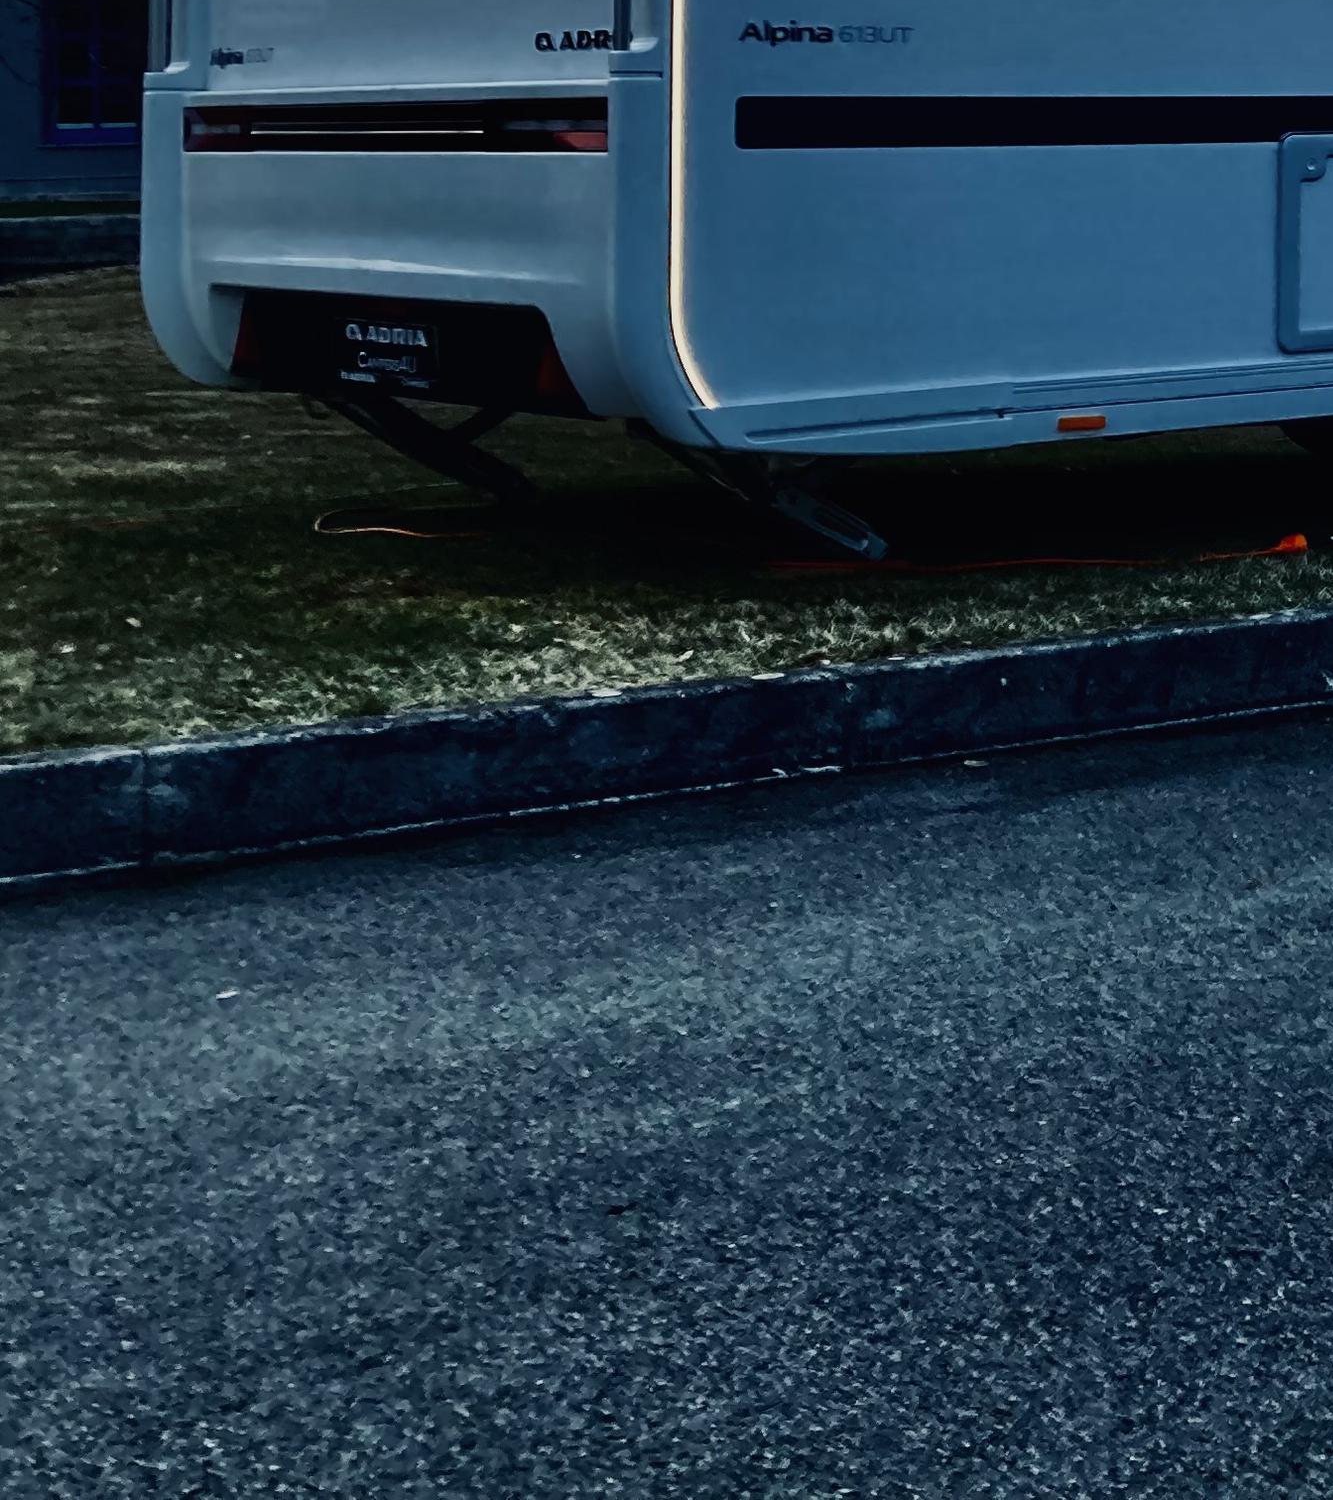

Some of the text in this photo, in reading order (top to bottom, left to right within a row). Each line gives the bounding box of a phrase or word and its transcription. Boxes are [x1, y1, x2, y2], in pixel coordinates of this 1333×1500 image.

[559, 29, 633, 51] ADR
[738, 20, 834, 47] Alpina
[367, 325, 428, 347] ADRIA
